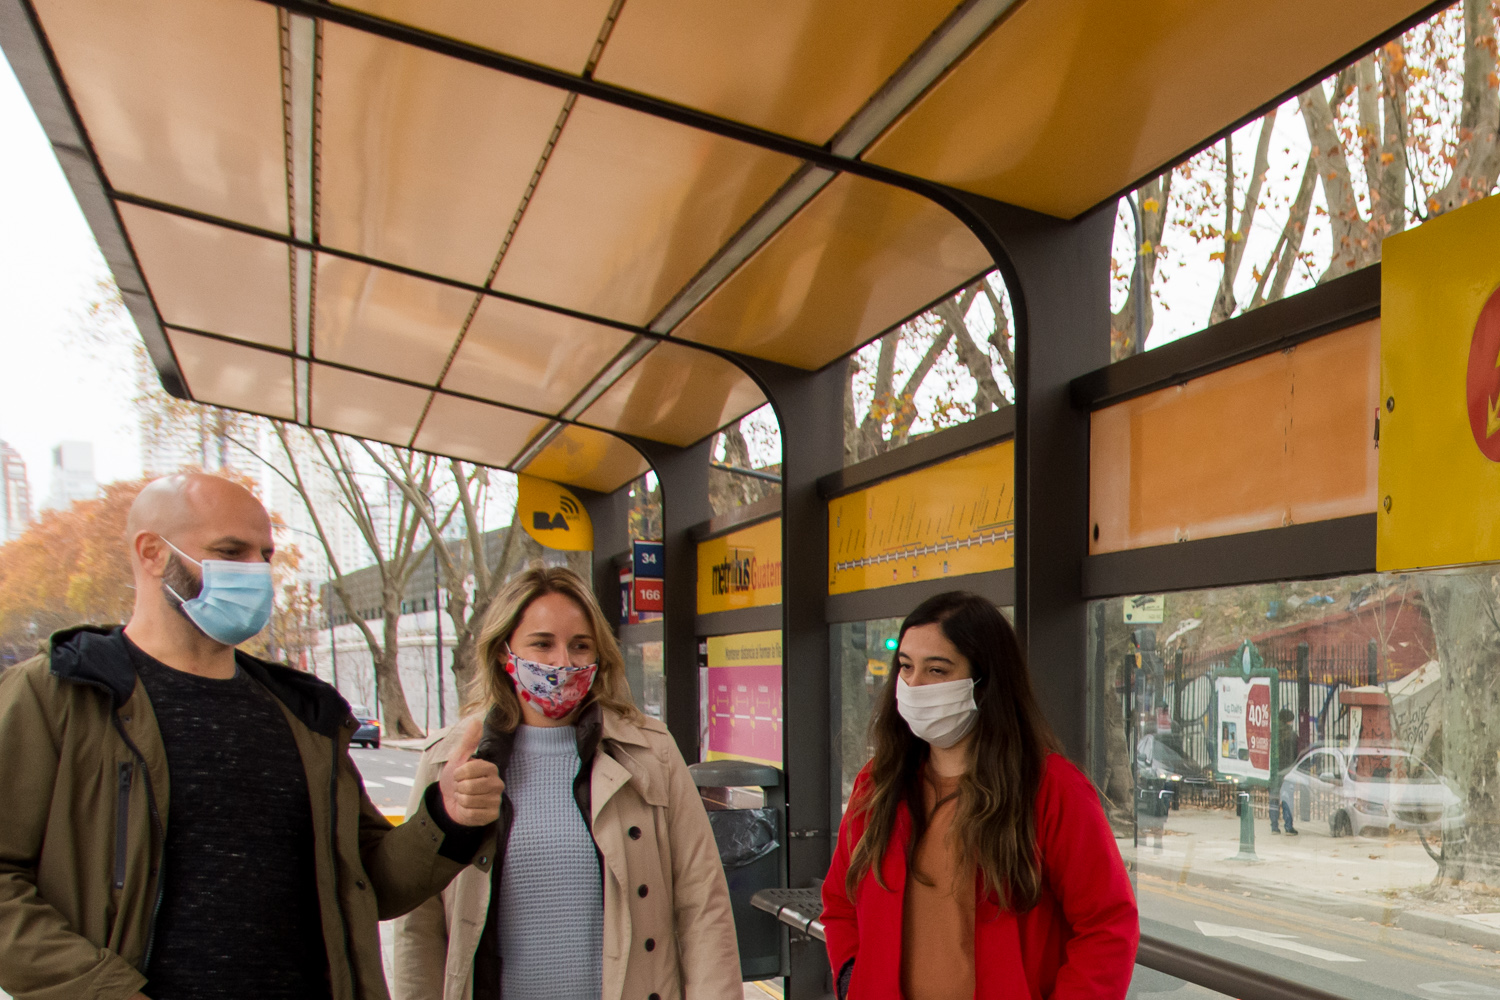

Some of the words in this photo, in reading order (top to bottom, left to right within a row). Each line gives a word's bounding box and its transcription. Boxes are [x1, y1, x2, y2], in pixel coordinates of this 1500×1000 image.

[533, 511, 570, 531] BA
[641, 552, 657, 565] 34
[640, 589, 661, 601] 166
[1249, 704, 1269, 727] 40%
[1250, 735, 1256, 749] 9
